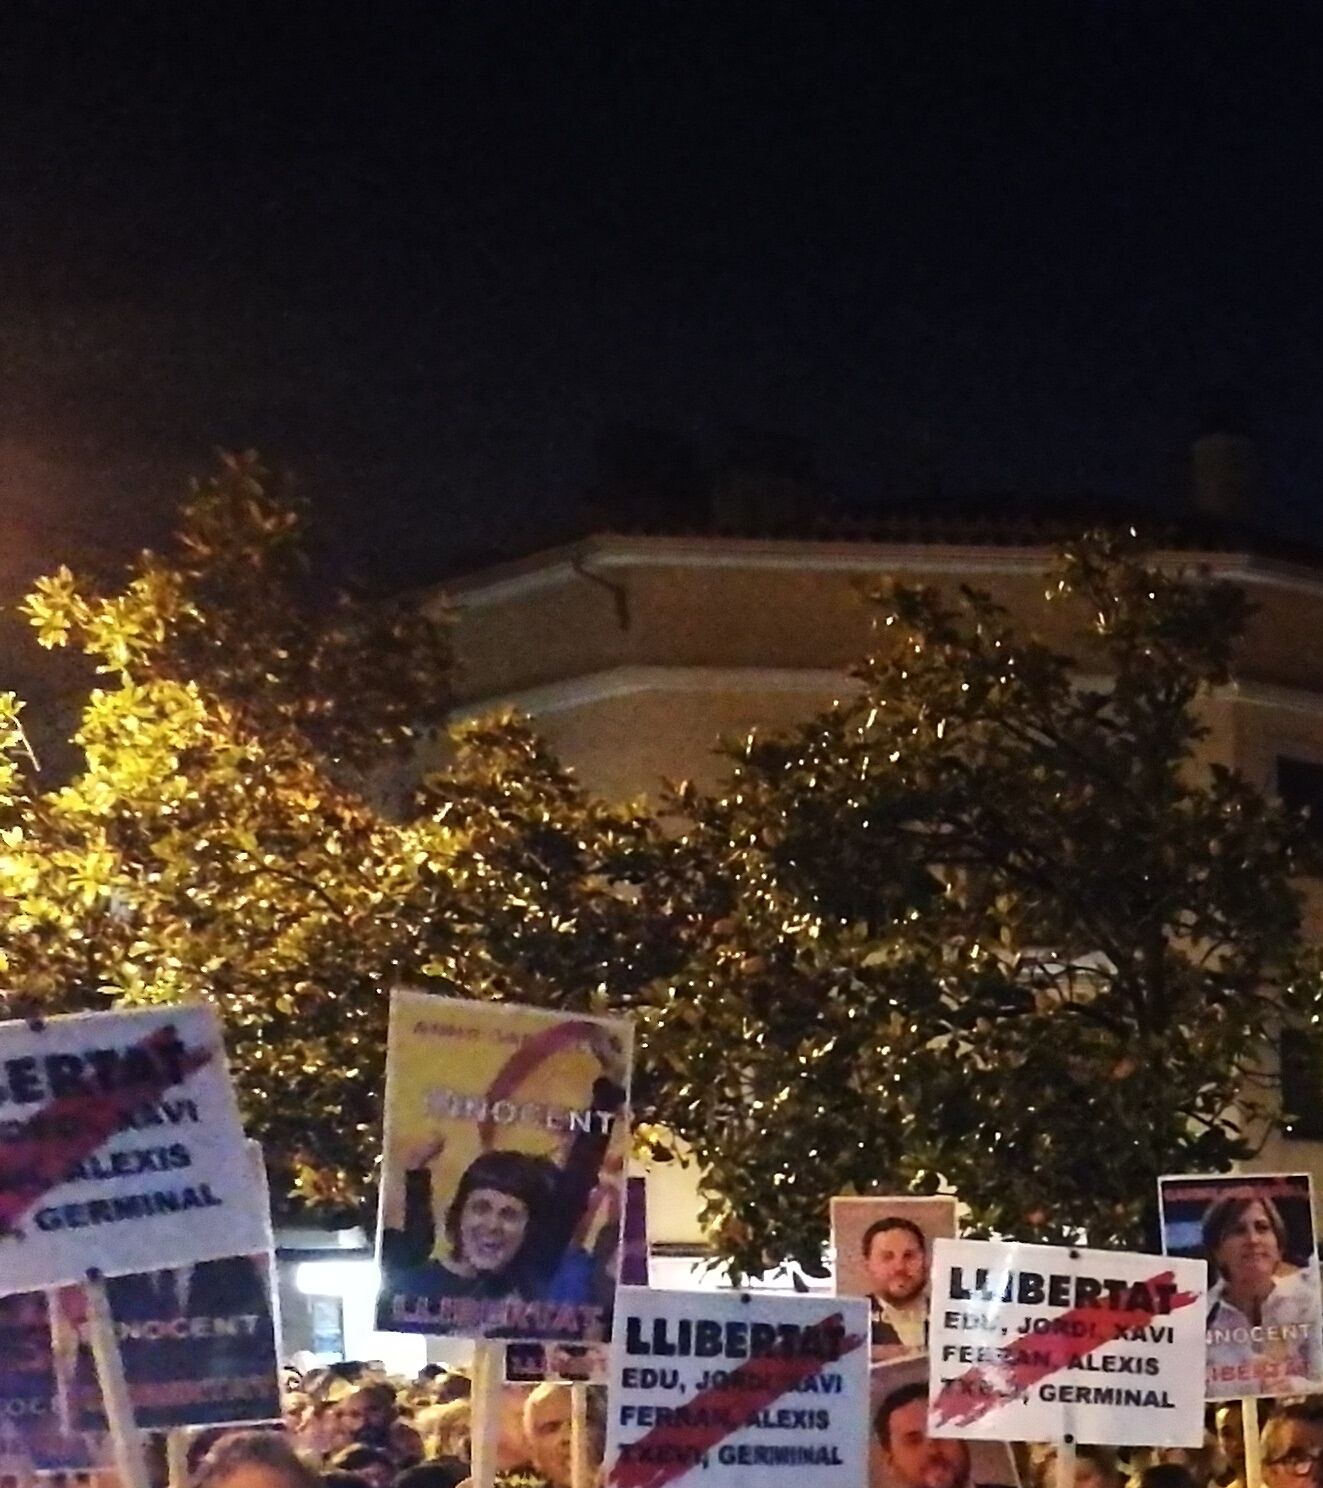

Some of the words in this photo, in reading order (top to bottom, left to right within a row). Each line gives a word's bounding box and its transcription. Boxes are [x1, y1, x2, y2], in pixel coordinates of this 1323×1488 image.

[0, 1040, 186, 1104] ERTAT
[33, 1182, 223, 1231] GERMINAL
[949, 1266, 1179, 1316] LLIBERTAT
[625, 1316, 846, 1362] LLIBERTAT
[1113, 1322, 1175, 1344] XAVI
[1066, 1353, 1161, 1376] ALEXIS
[621, 1367, 686, 1394] EDU,
[1037, 1383, 1176, 1410] GERMINAL
[745, 1409, 830, 1431] ALEXIS
[717, 1444, 844, 1466] GERMINAL
